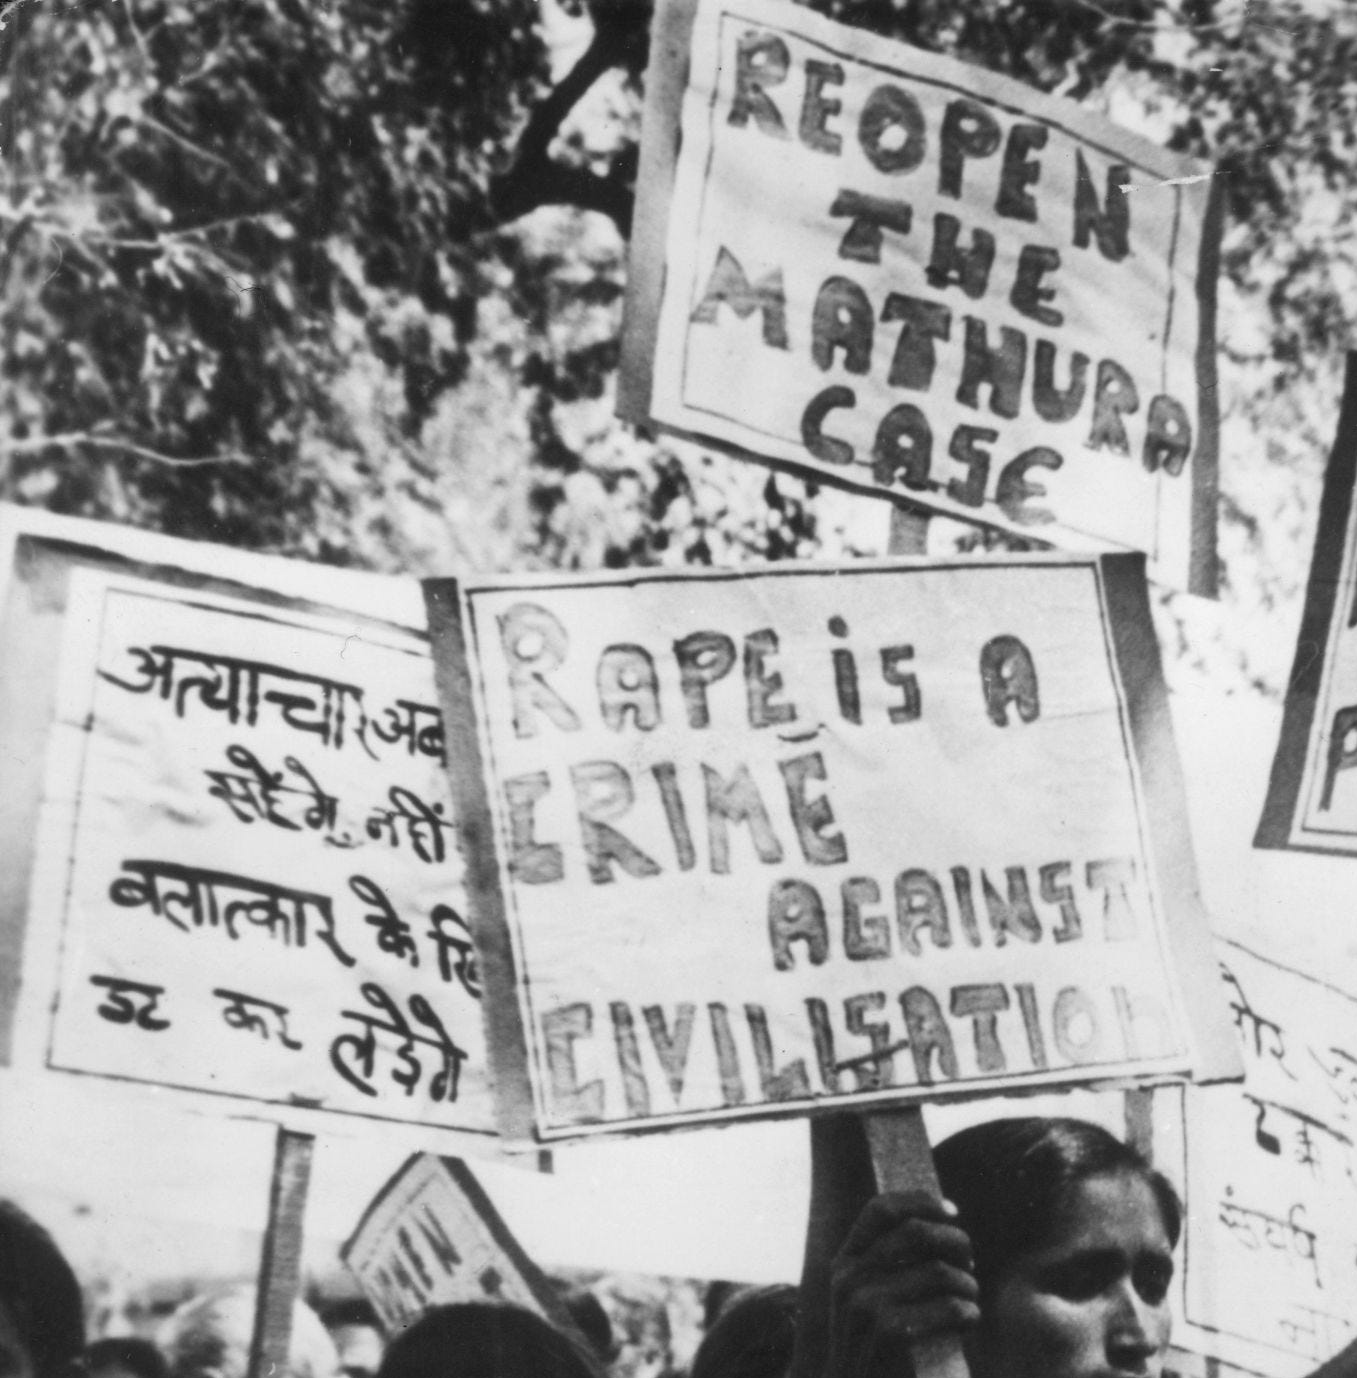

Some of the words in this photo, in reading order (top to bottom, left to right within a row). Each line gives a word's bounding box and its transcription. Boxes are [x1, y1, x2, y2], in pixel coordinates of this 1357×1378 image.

[727, 31, 1131, 262] REOPEN
[829, 189, 1064, 327] THE
[690, 245, 1192, 477] MATHURA
[801, 385, 1064, 525] CASE
[498, 603, 797, 740] RAPE
[979, 634, 1042, 727] A
[503, 751, 850, 885] CRIME
[768, 856, 1139, 972] AGAINST
[540, 983, 1172, 1123] CIVILISATION
